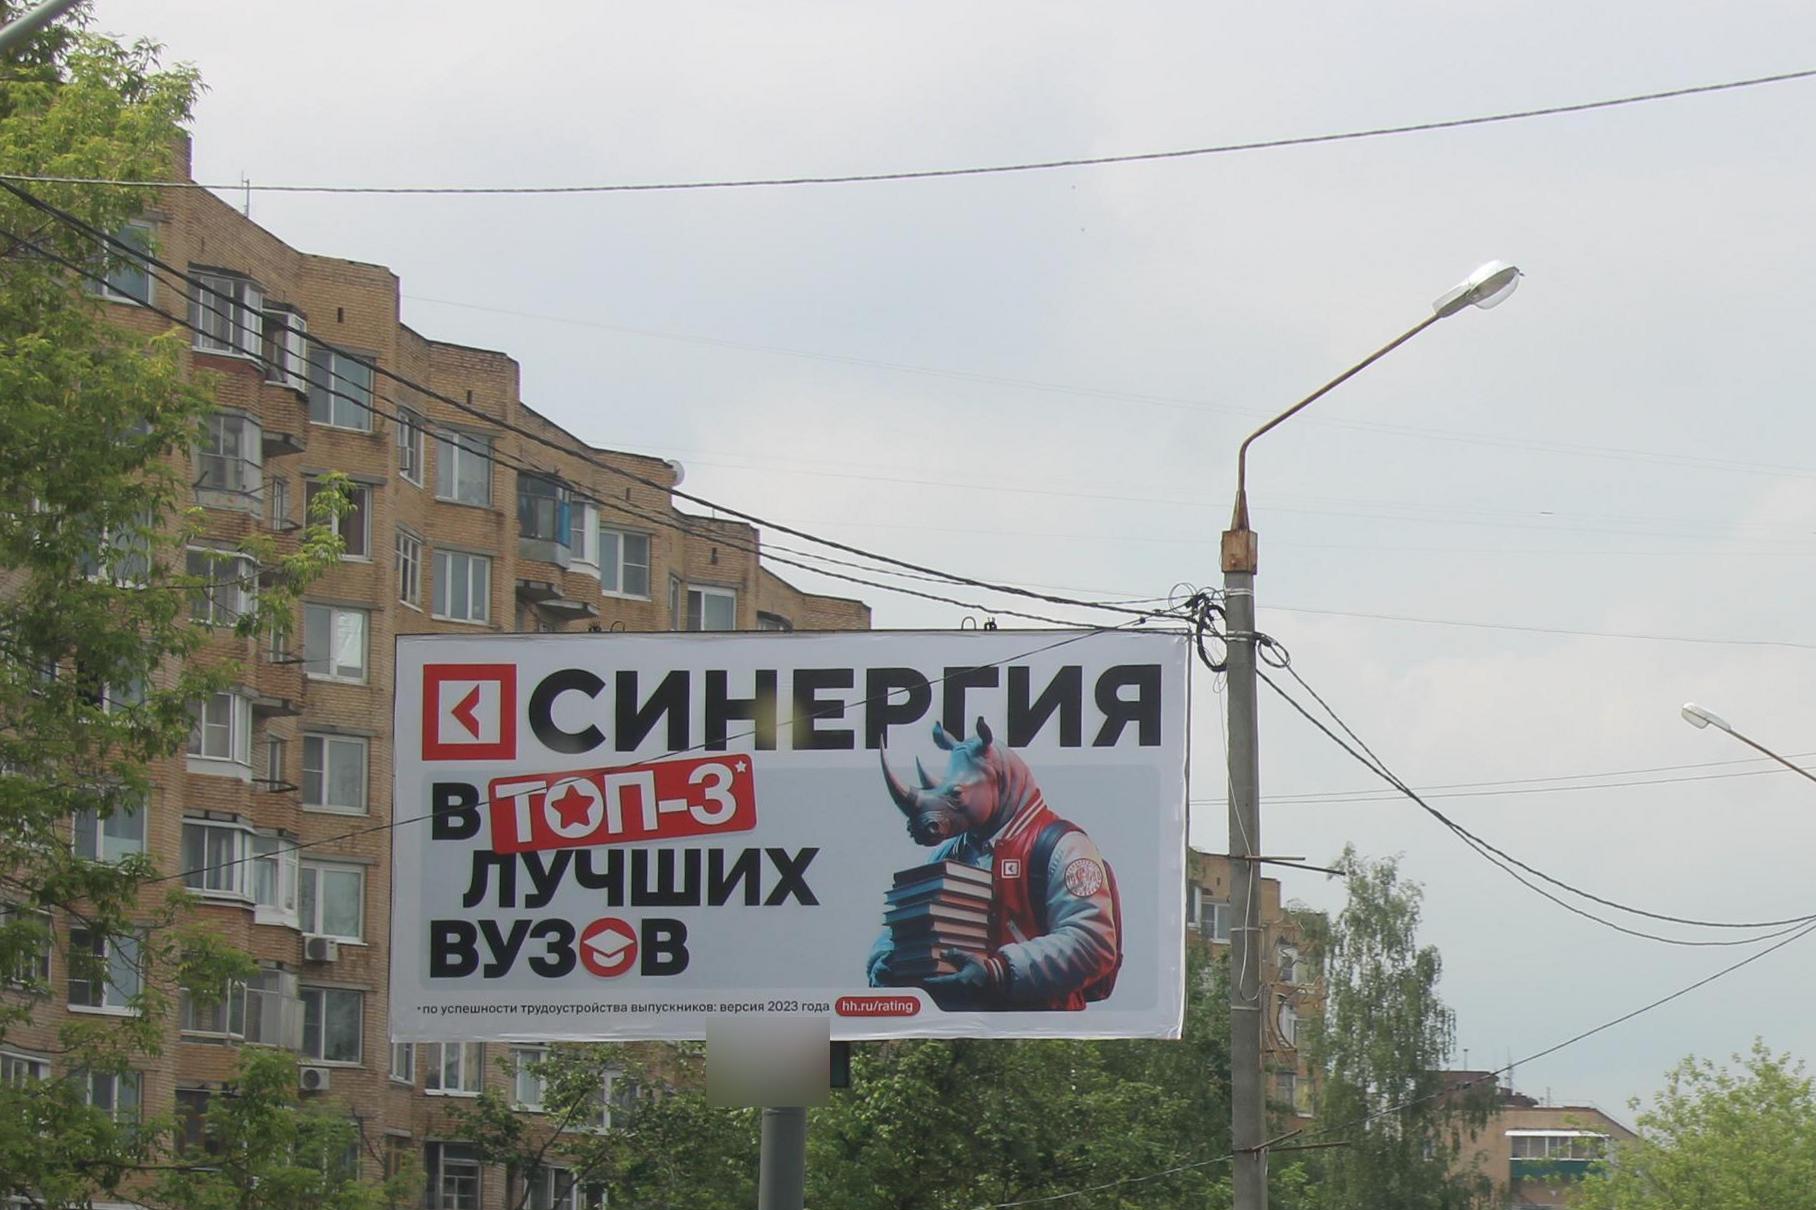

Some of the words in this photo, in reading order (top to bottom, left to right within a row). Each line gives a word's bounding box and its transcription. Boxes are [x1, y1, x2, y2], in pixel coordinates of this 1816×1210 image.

[528, 664, 1162, 753] СИНЕРГИЯ
[432, 782, 481, 840] В
[495, 762, 737, 843] ТОП-3
[462, 847, 821, 909] ЛУЧШИХ
[430, 917, 690, 979] ВУЗОВ
[441, 1003, 518, 1016] успешности
[521, 1001, 628, 1016] трудоустройства
[630, 1002, 717, 1016] выпускников:
[720, 1003, 765, 1014] версия
[768, 1001, 799, 1012] 2023
[802, 1003, 830, 1013] года
[841, 996, 914, 1014] hh.ru/rating
